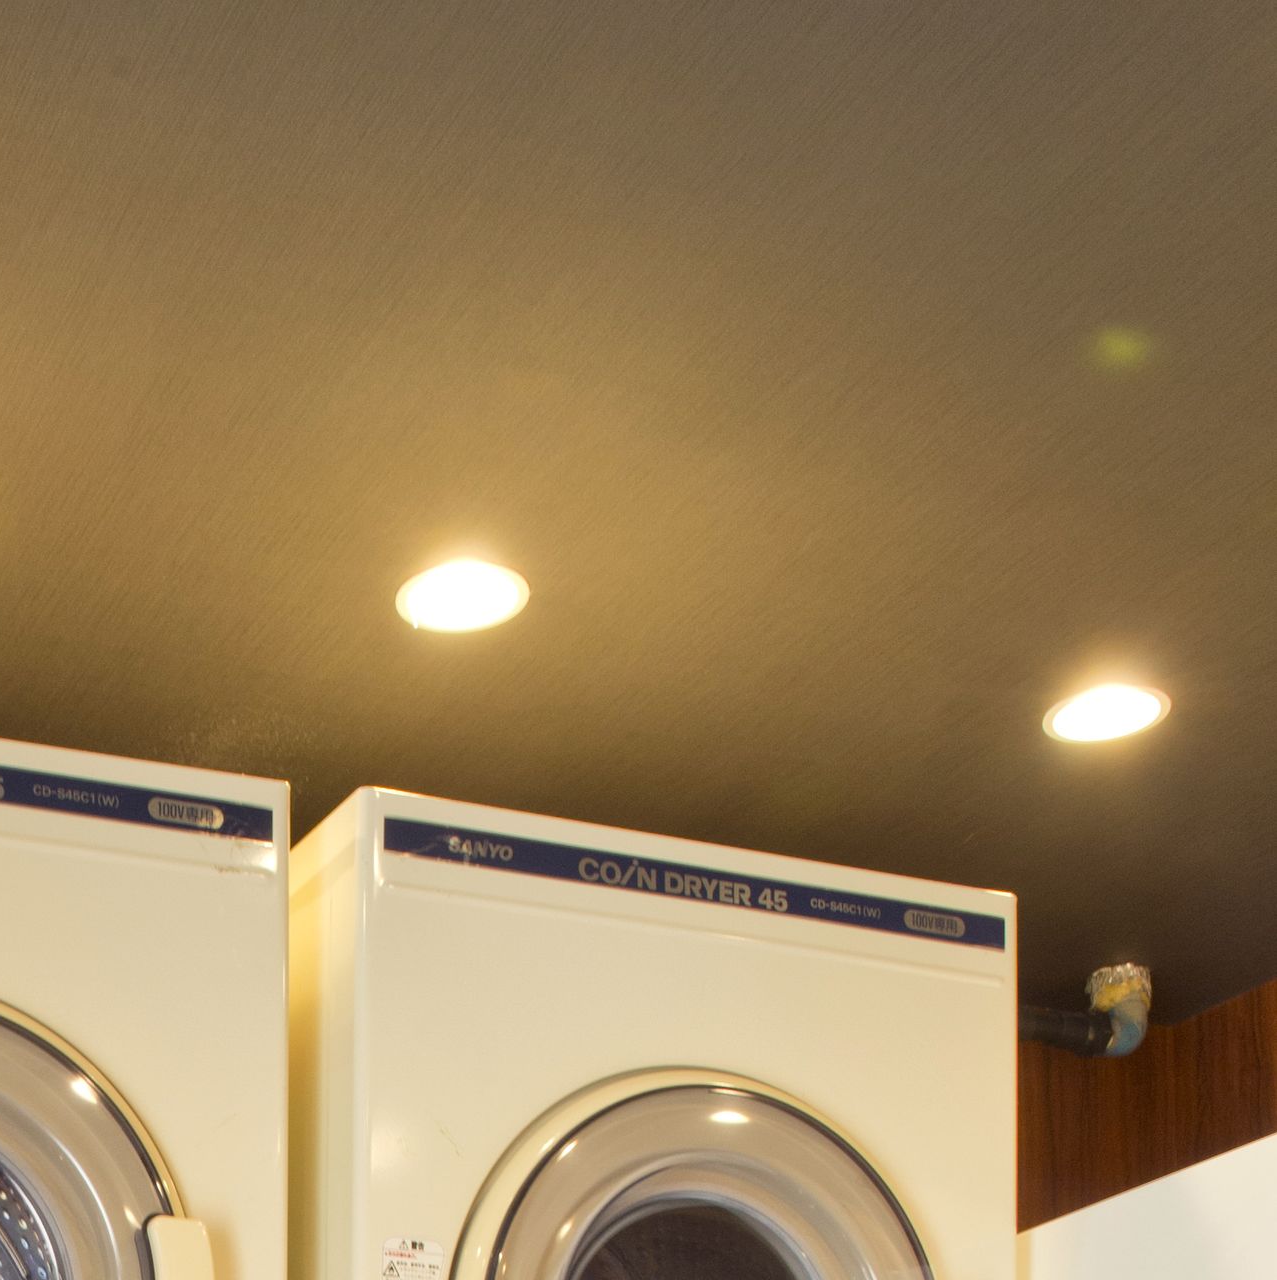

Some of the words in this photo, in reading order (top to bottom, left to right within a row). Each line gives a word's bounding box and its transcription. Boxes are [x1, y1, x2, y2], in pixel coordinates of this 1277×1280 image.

[448, 836, 514, 861] SANYO
[663, 871, 752, 906] DRYER
[758, 887, 789, 913] 45
